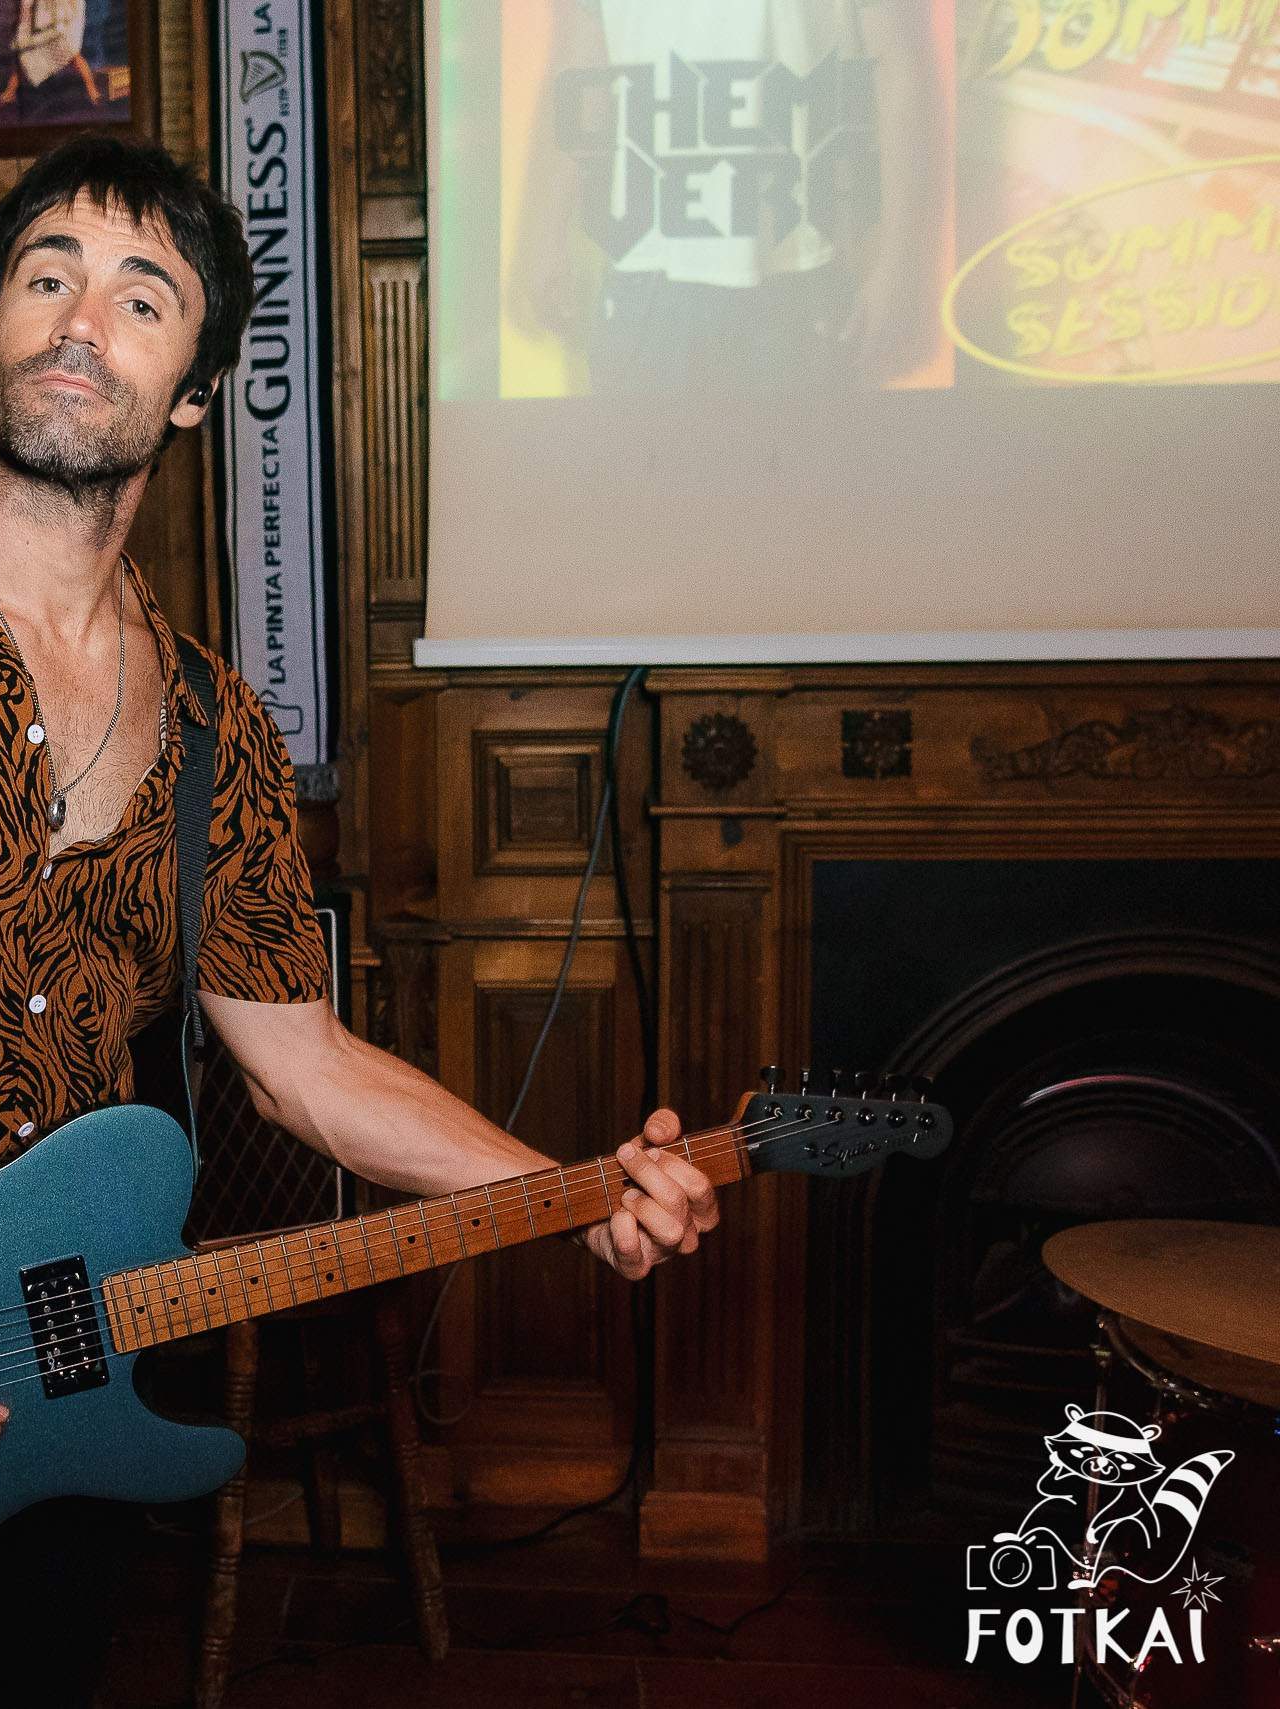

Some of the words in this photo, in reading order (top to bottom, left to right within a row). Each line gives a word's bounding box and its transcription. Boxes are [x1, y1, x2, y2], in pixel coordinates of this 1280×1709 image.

[245, 121, 292, 422] GUINNESS
[1006, 203, 1280, 289] SUMM
[1006, 276, 1280, 358] SESSIO
[262, 426, 282, 567] PERFECTA
[264, 573, 285, 651] PINTA
[267, 656, 286, 685] LA
